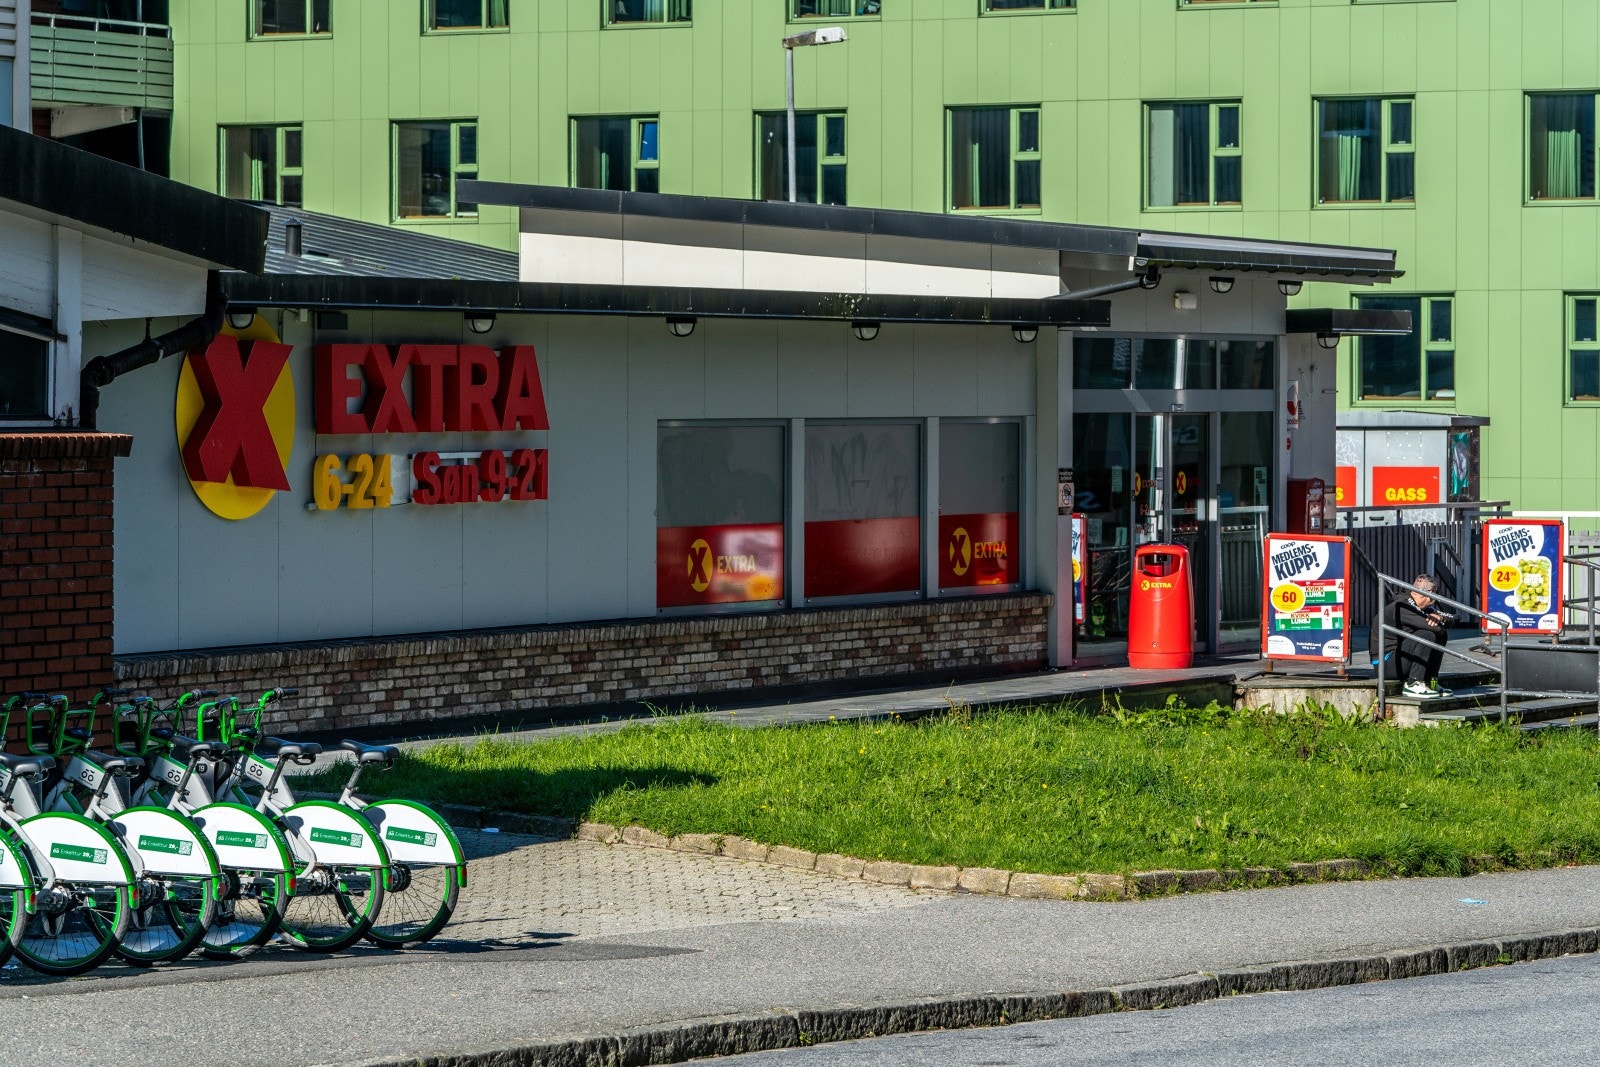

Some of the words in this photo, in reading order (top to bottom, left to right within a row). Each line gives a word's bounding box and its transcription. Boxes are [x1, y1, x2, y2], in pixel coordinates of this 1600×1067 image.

[315, 343, 550, 435] EXTRA
[313, 453, 393, 511] 6-24
[1385, 487, 1427, 501] GASS
[1280, 541, 1296, 550] coop
[1490, 528, 1530, 548] MEDLEMS-
[974, 541, 1007, 558] EXTRA
[1271, 543, 1314, 565] MEDLEMS-
[1493, 535, 1536, 562] KUPP!
[717, 554, 756, 573] EXTRA
[1274, 551, 1320, 581] KUPP!
[1496, 571, 1511, 582] 24
[1282, 591, 1297, 603] 60
